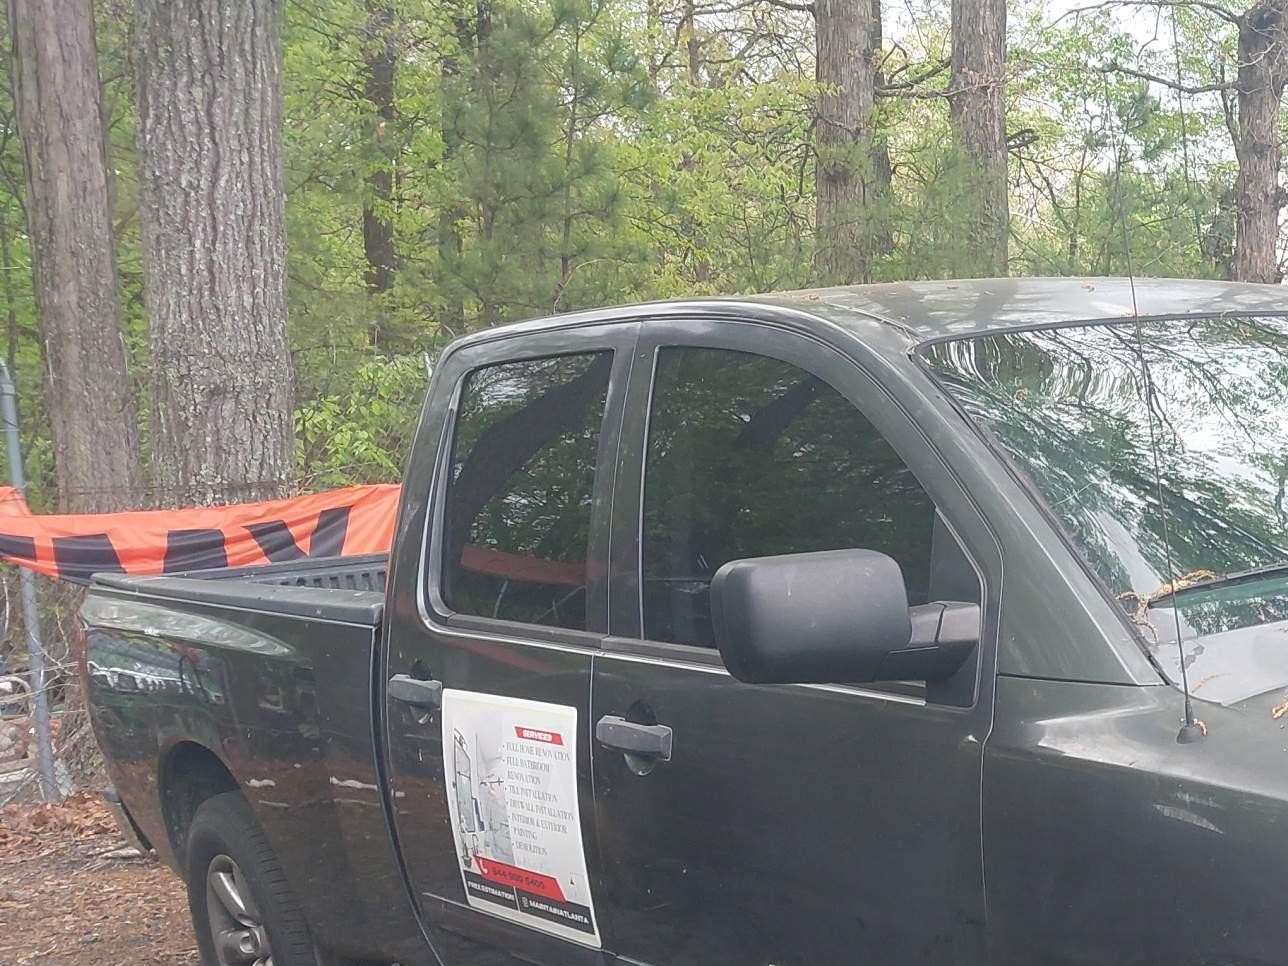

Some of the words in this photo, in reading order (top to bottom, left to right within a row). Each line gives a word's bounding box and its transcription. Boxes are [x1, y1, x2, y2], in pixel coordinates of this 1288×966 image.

[535, 746, 571, 761] RENOVATION
[507, 770, 541, 785] RENOVATION
[521, 787, 558, 802] INSTALLATION
[535, 804, 575, 821] INSTALLATION
